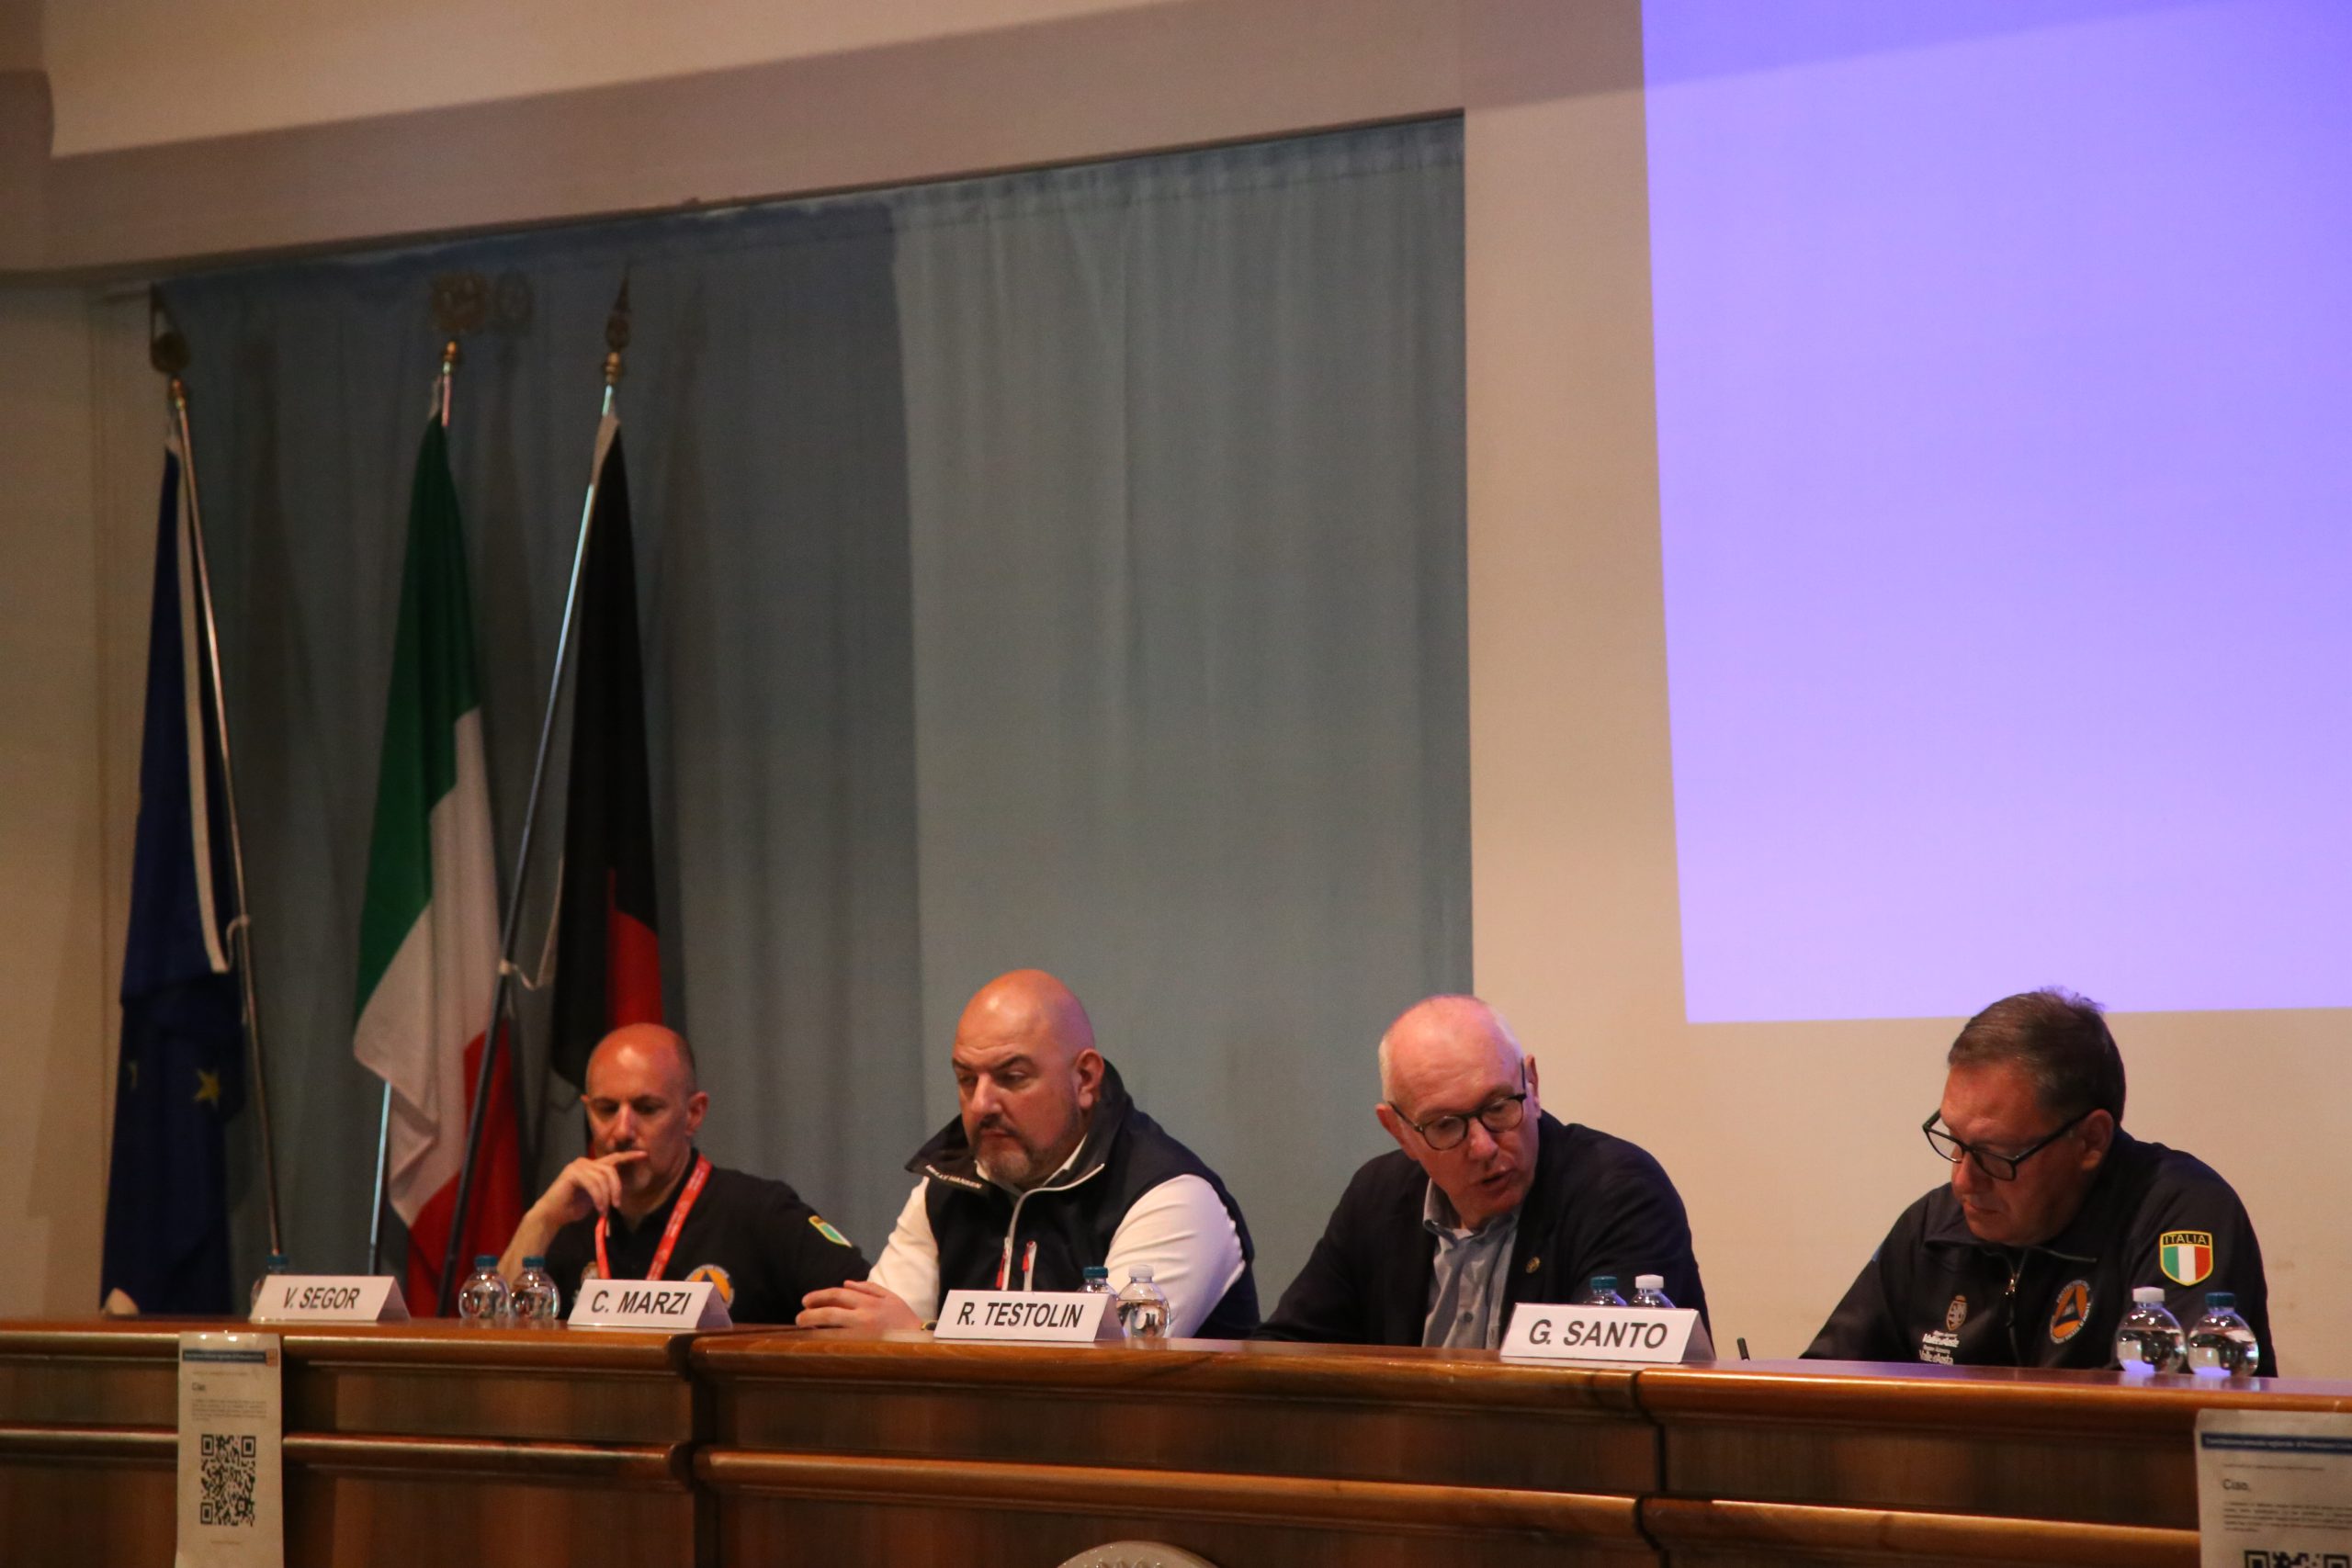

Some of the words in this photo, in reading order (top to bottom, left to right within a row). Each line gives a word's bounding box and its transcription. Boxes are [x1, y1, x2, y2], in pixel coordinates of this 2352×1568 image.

[2165, 1234, 2207, 1245] ITALIA
[283, 1287, 298, 1308] V.
[300, 1287, 360, 1309] SEGOR
[591, 1290, 609, 1313] C.
[616, 1291, 692, 1314] MARZI
[956, 1302, 976, 1325] R.
[984, 1302, 1084, 1328] TESTOLIN
[1529, 1319, 1552, 1345] G.
[1564, 1320, 1668, 1348] SANTO
